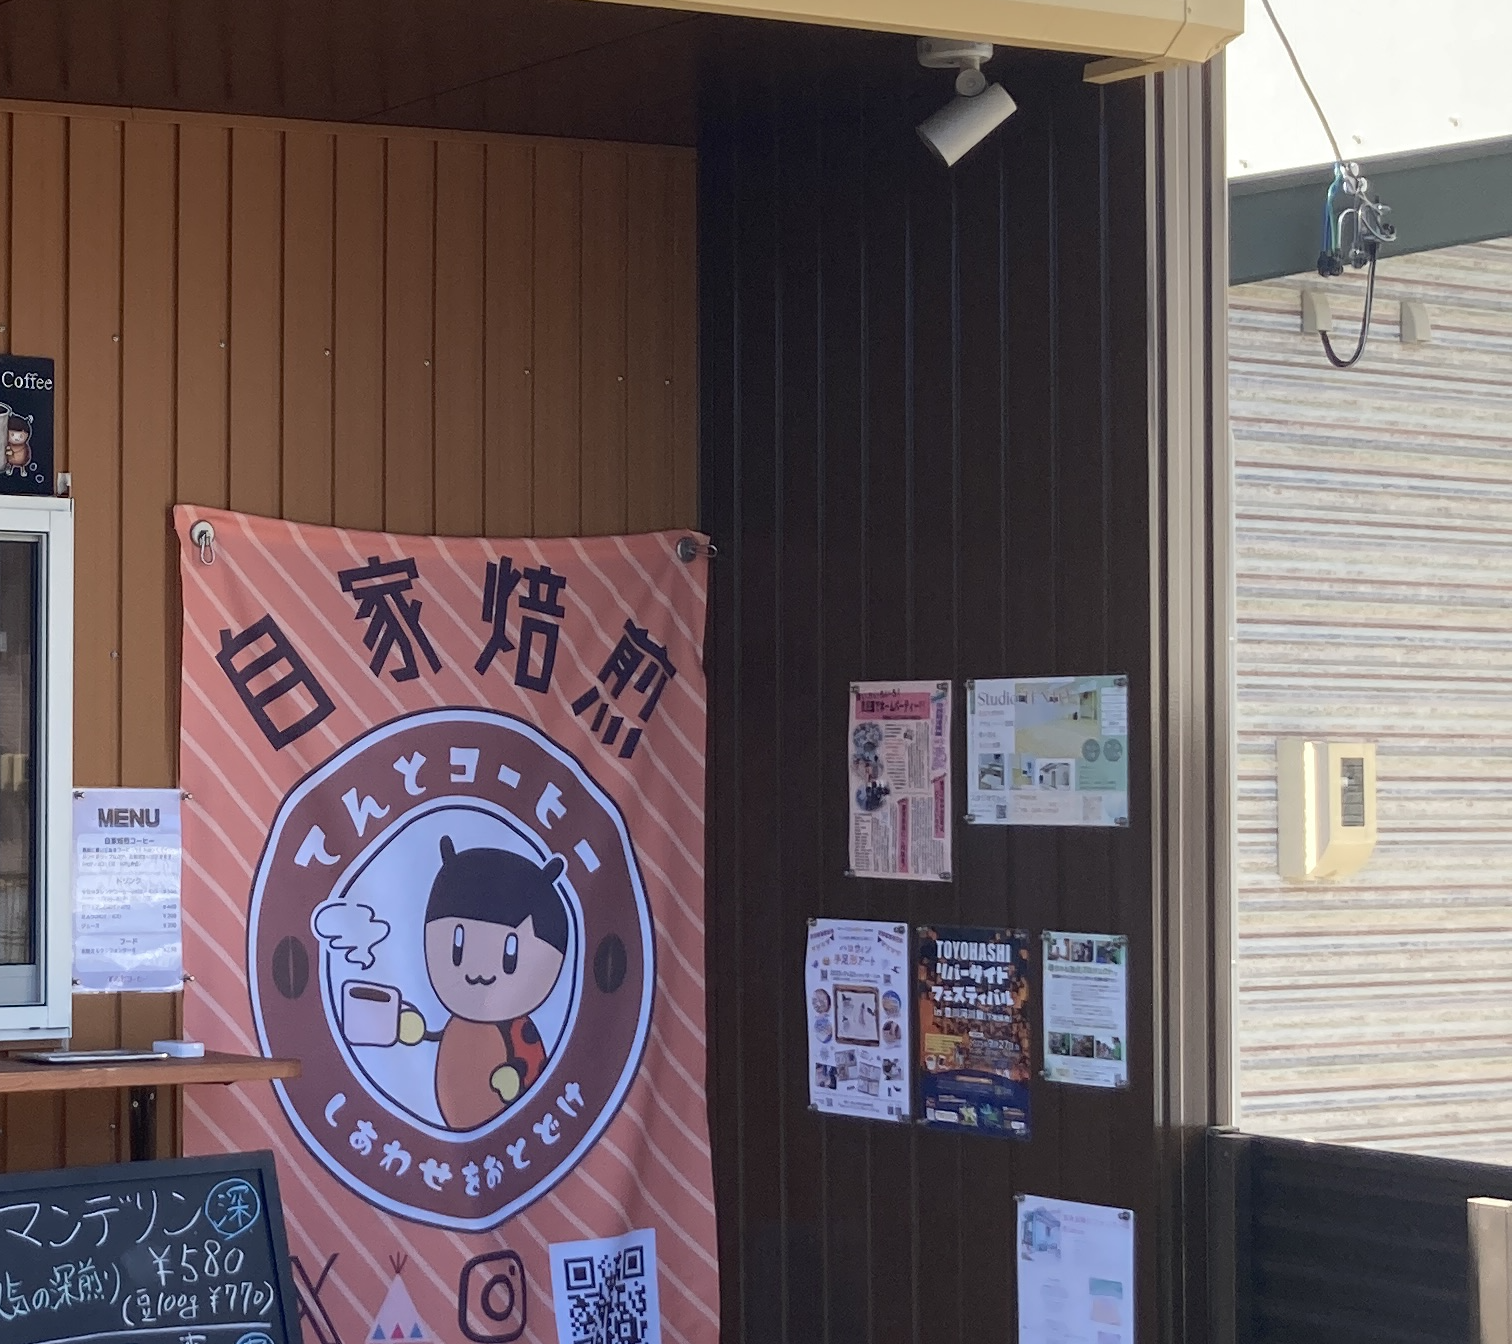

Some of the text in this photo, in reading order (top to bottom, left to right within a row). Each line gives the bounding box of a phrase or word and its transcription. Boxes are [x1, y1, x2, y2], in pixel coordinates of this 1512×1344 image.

[1, 371, 53, 391] Coffee
[215, 556, 676, 759] 自家焙煎
[97, 808, 160, 828] MENU
[294, 746, 601, 873] てんとコーヒー
[935, 940, 1011, 963] TOYOHASHI
[935, 962, 1009, 985] リバーサイド
[324, 1080, 585, 1197] しあわせをおとどけ
[148, 1240, 244, 1286] ¥580
